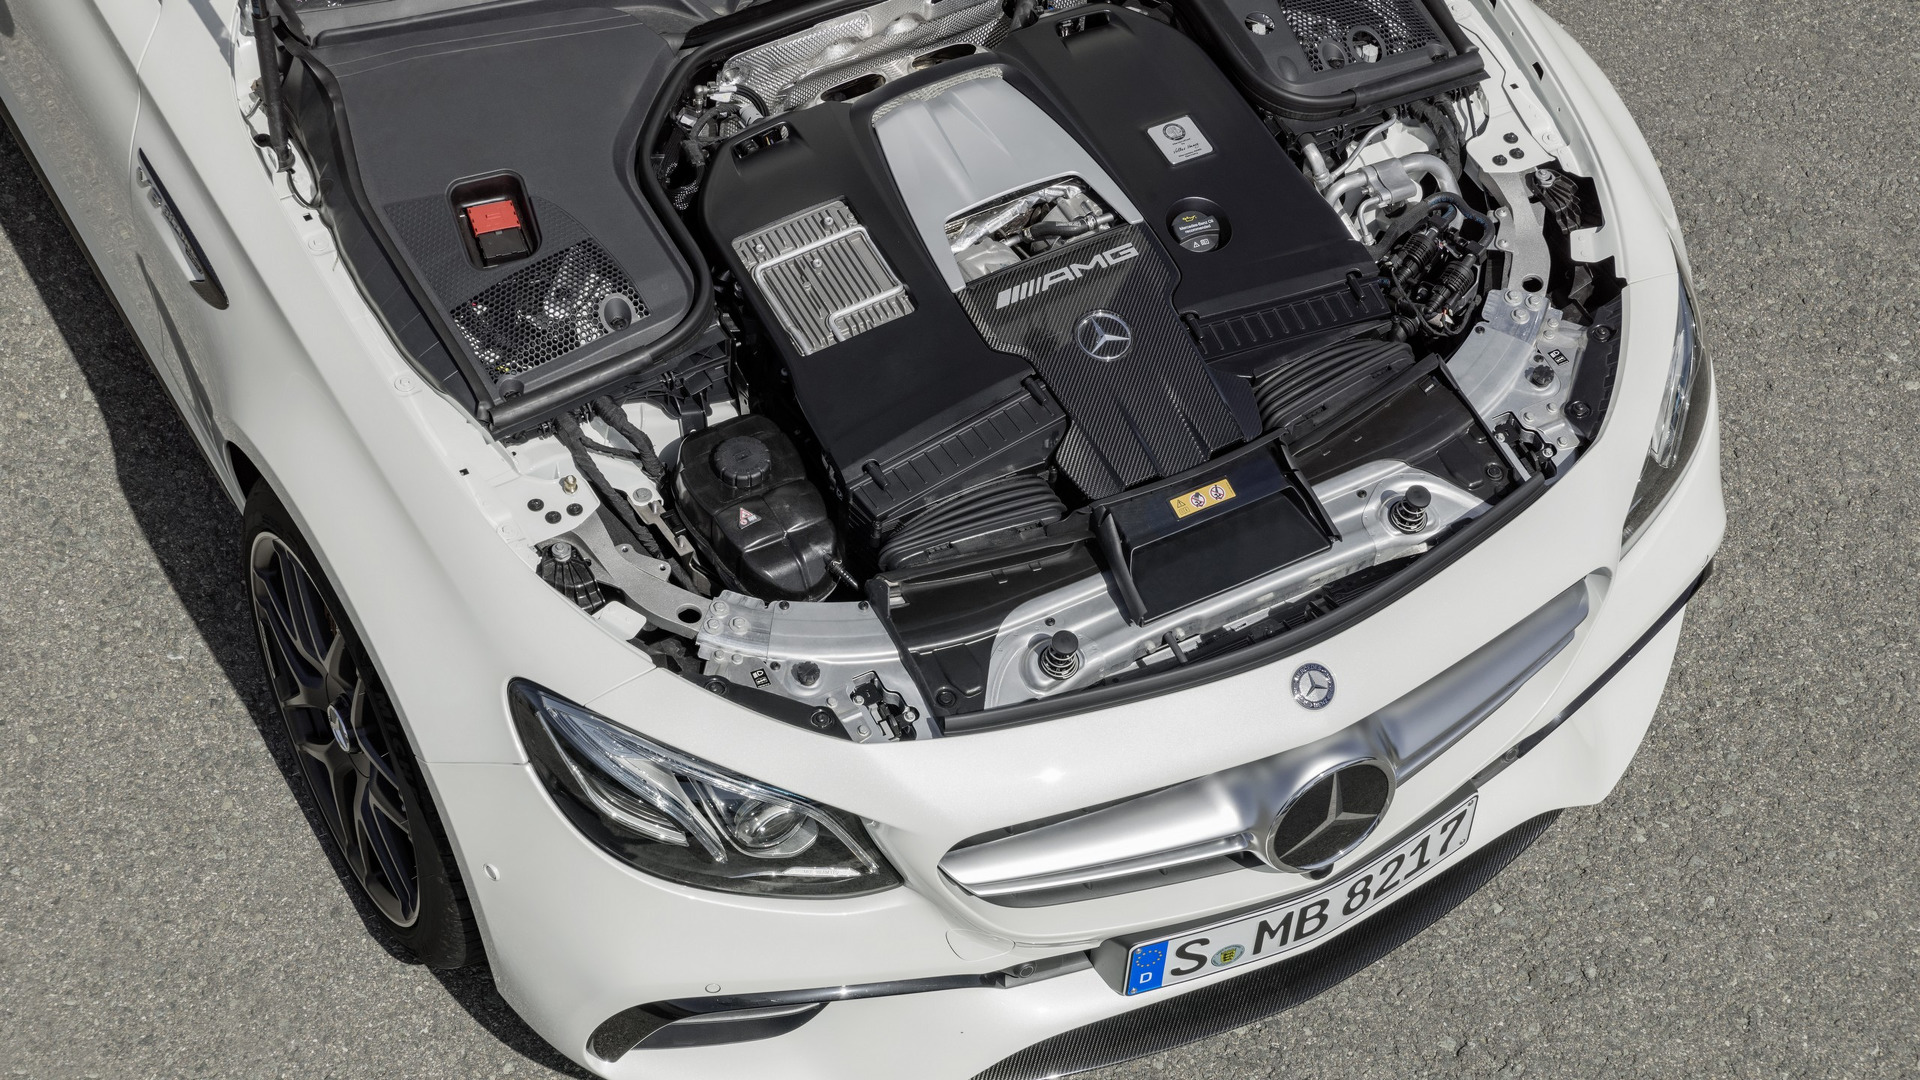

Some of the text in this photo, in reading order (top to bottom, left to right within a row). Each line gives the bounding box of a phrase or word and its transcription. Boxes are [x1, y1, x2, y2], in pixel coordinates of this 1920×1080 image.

[1041, 242, 1139, 292] AMG
[1170, 808, 1467, 978] S MB 8217
[1139, 971, 1152, 985] D
